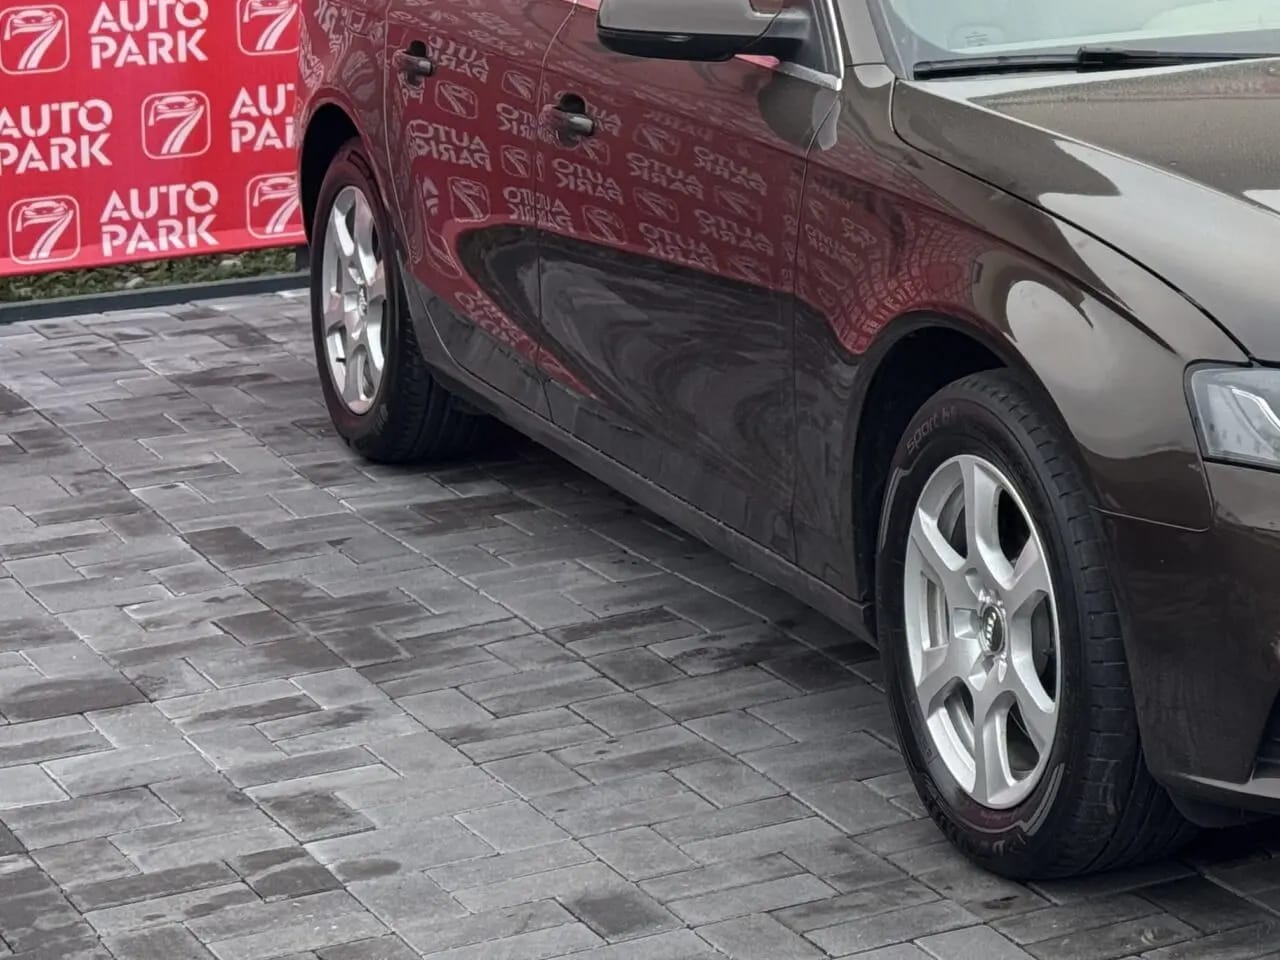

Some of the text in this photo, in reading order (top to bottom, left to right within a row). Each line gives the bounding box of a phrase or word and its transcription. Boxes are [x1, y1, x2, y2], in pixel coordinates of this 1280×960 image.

[91, 29, 207, 69] PARK
[229, 83, 295, 120] AU
[0, 133, 112, 175] PARK
[100, 181, 218, 223] AUTO
[102, 215, 219, 257] PARK
